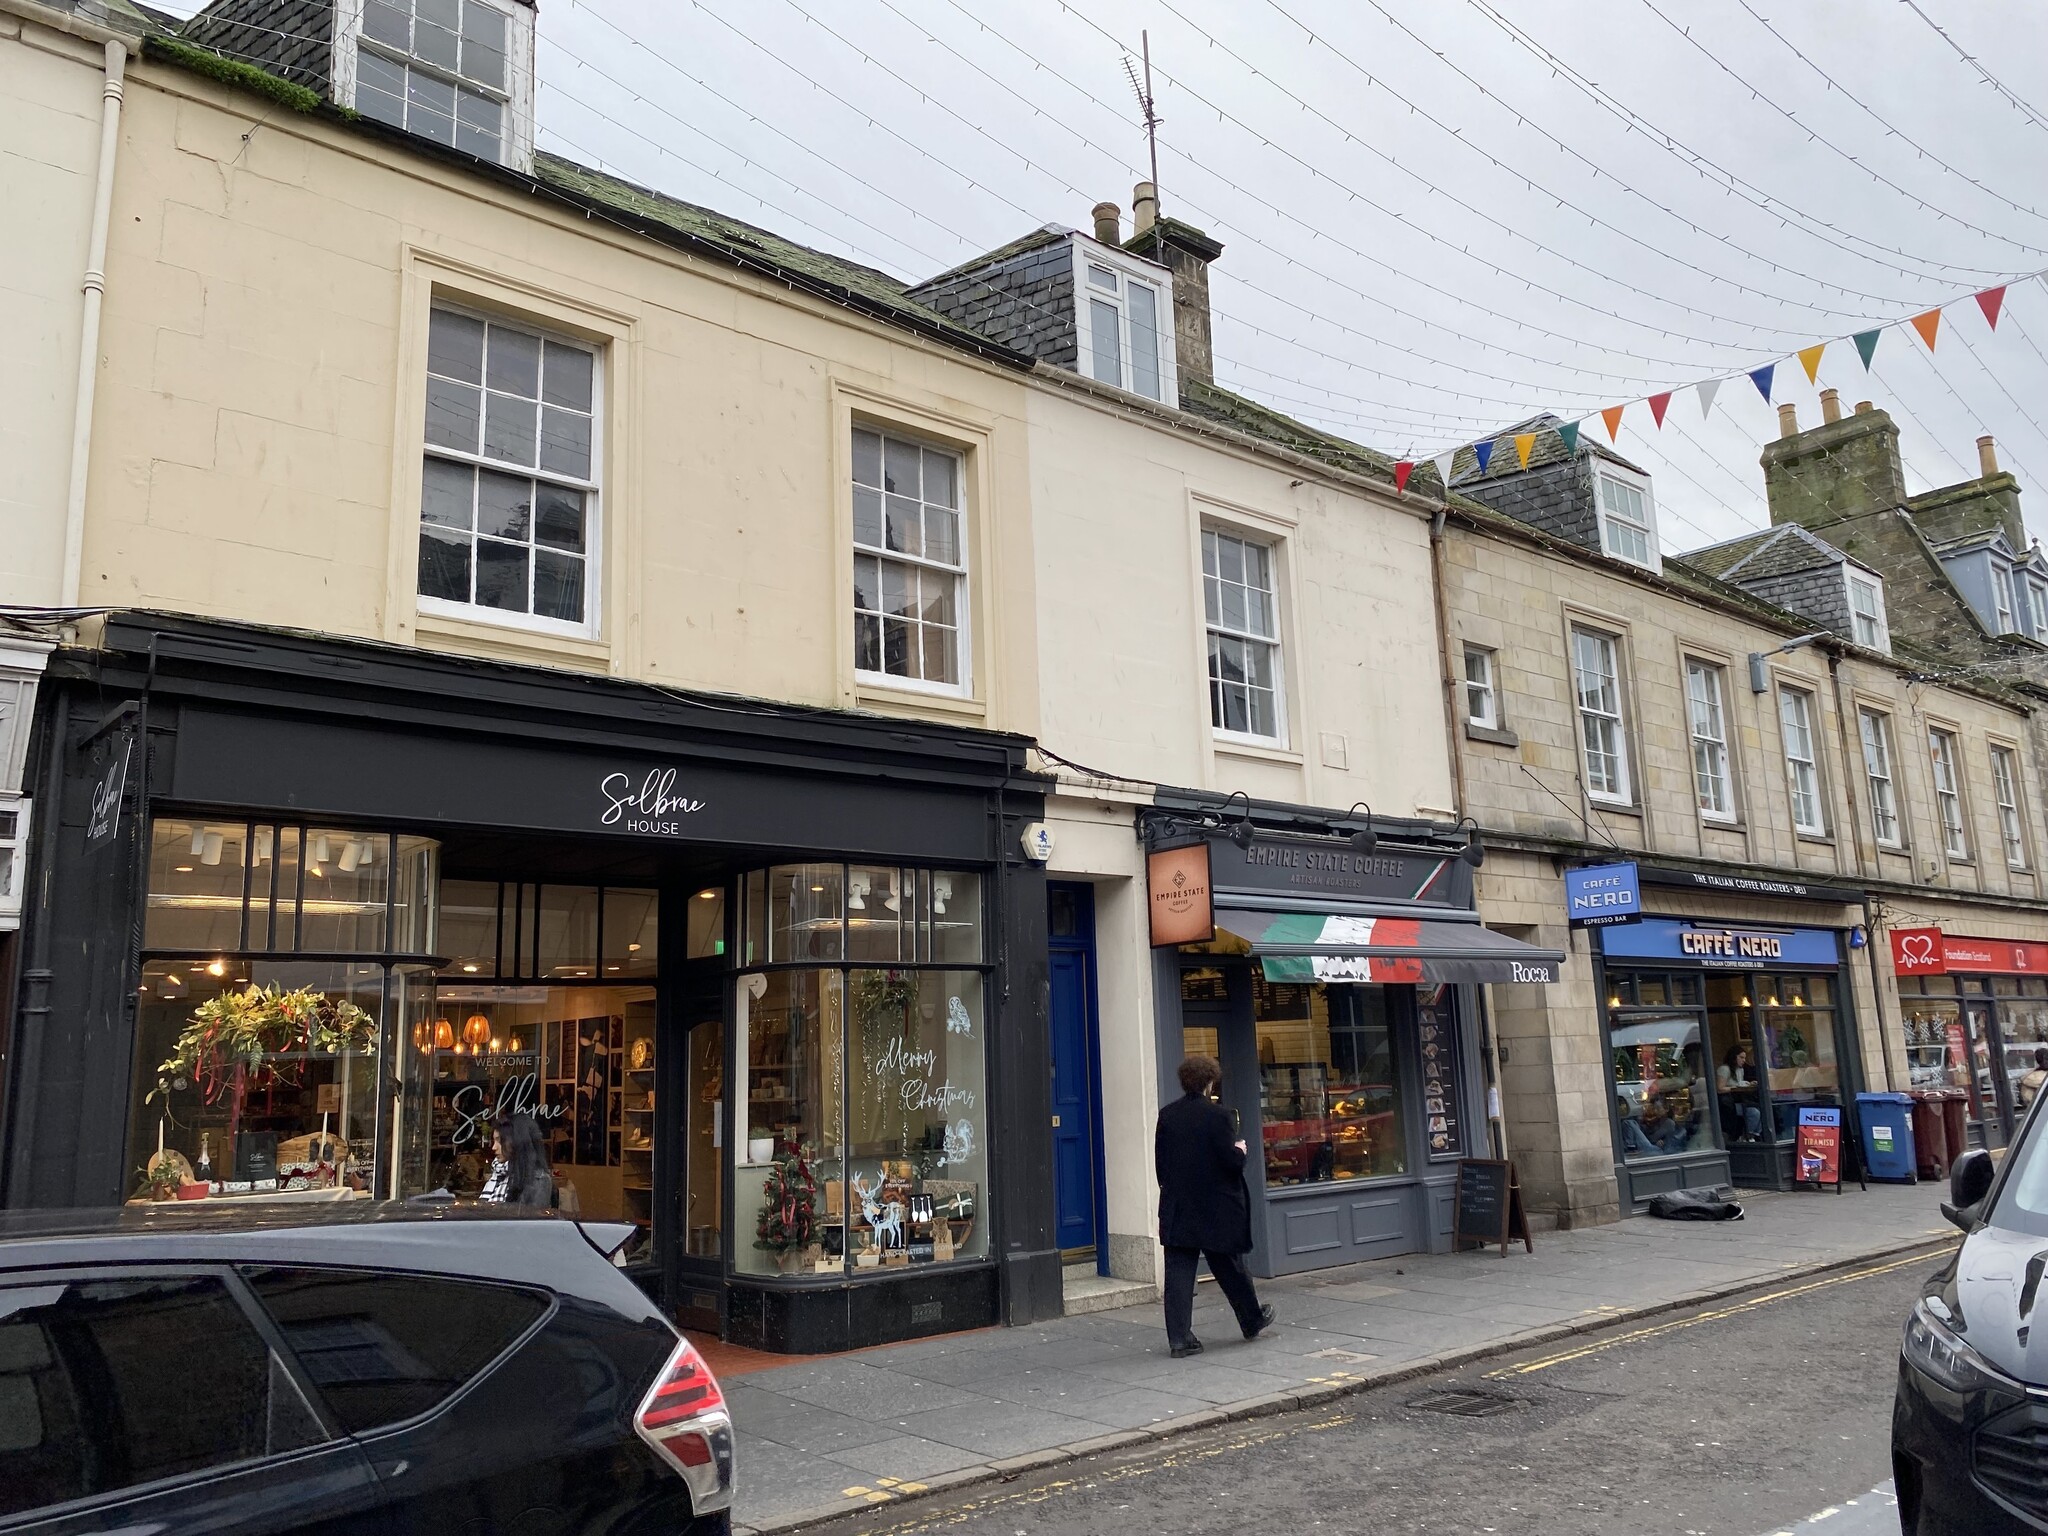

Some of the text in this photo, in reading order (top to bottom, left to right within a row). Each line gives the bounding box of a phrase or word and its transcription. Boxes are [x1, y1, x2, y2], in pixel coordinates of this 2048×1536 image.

[601, 768, 706, 825] Selbrae
[627, 819, 679, 835] HOUSE
[1246, 846, 1405, 878] EMPIRE STATE COFFEE
[1290, 874, 1361, 889] ARTISAN ROASTERS
[1692, 873, 1807, 894] THE ITALIAN COFFEE ROASTERS DELI
[1156, 886, 1205, 902] EMPIRE STATE
[1574, 890, 1632, 909] NERO
[1583, 917, 1614, 925] ESPRESSO
[1739, 936, 1782, 957] NERO
[1944, 948, 1972, 960] Foundation
[1510, 961, 1550, 983] Rocca
[475, 1056, 550, 1067] WELCOME TO
[875, 1035, 937, 1077] Merry
[901, 1078, 976, 1114] Christmas
[1804, 1137, 1834, 1146] TIRAMISU
